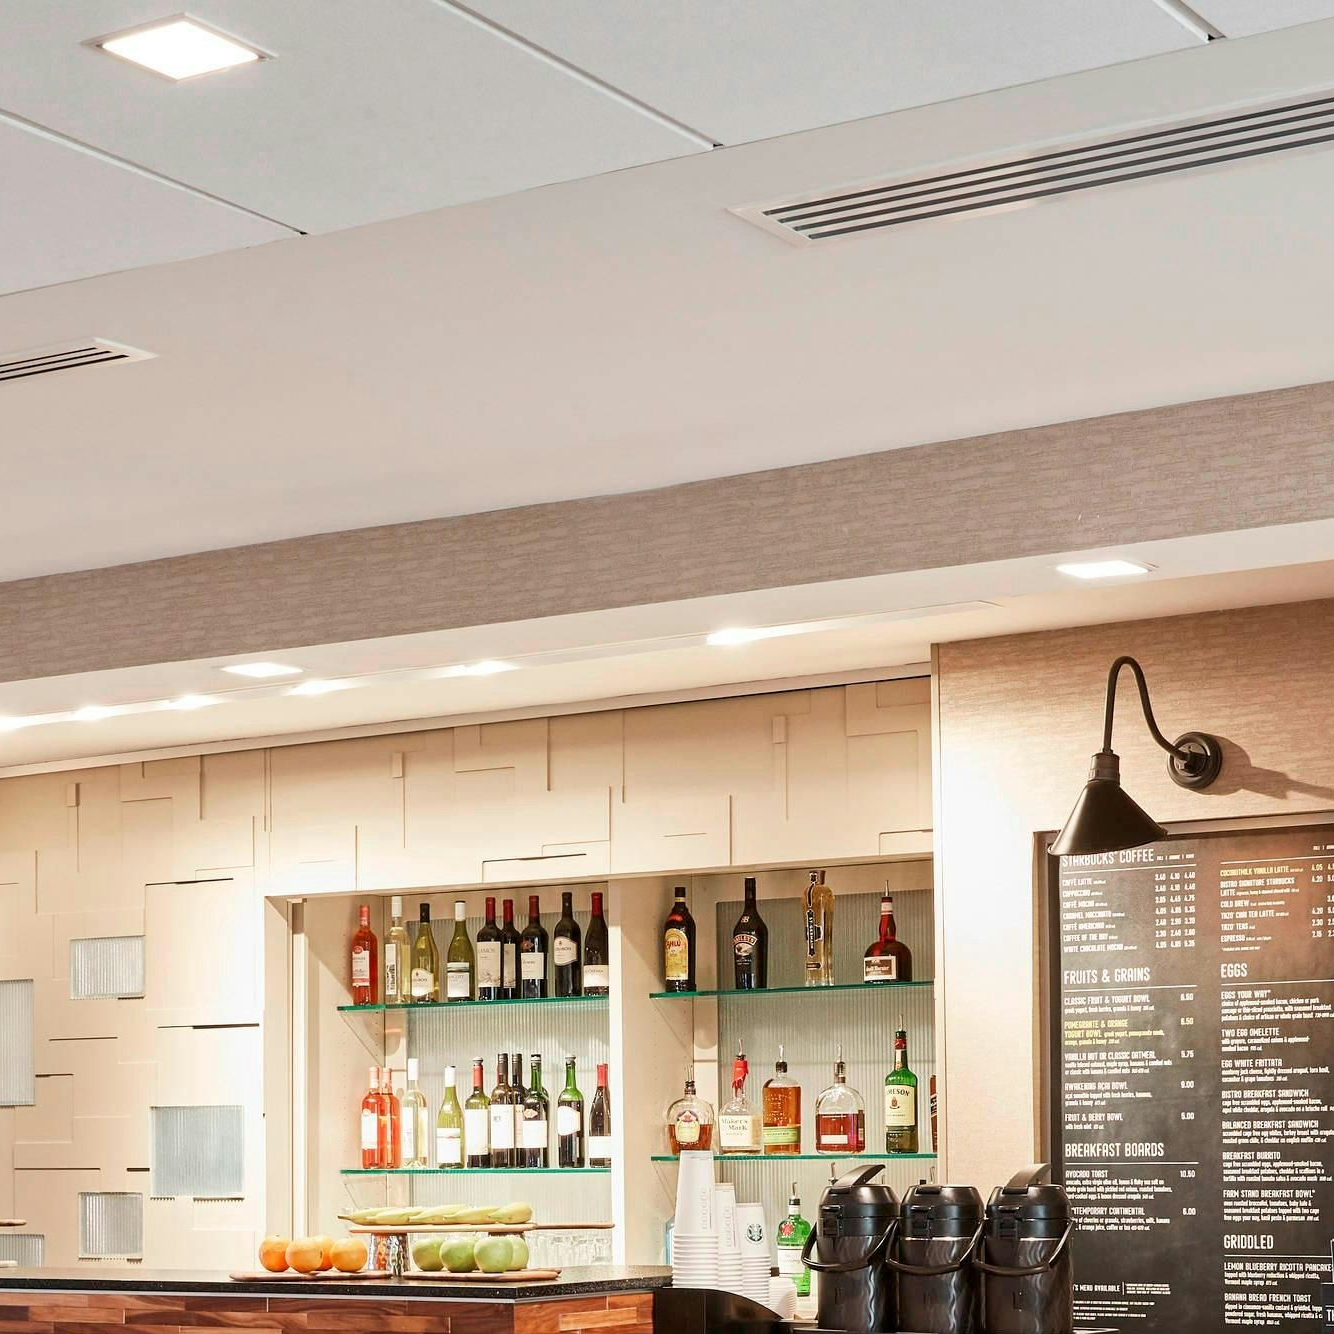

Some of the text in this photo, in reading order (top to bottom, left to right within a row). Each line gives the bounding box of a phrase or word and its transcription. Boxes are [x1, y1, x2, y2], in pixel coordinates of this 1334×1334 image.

[1119, 848, 1155, 864] COFFEE
[1063, 967, 1151, 985] FRUITS & GRAINS
[1220, 963, 1248, 979] EGGS
[1133, 994, 1150, 1003] BOWL
[1220, 990, 1252, 999] EGGS YOUR
[1221, 1027, 1280, 1037] TWO EGG OMELETTE
[1221, 1058, 1283, 1068] EGG WHITE FRITTATA
[1111, 1081, 1128, 1090] BOWL
[1180, 1080, 1194, 1089] 9.00
[1221, 1089, 1309, 1099] BISTRO BREAKFAST SANDWICH
[1064, 1112, 1124, 1122] FRUIT & BERRY BOWL
[1181, 1112, 1195, 1120] 5.00
[1222, 1120, 1319, 1130] BALANCED BREAKFAST SANDWICH
[1065, 1142, 1164, 1158] BREAKFAST BOARDS
[1222, 1151, 1281, 1160] BREAKFAST BURRITO
[1065, 1169, 1108, 1178] AVOCADO TOAST
[1179, 1170, 1196, 1178] 10.50
[1223, 1189, 1294, 1198] FARM STAND BREAKFAST
[1109, 1207, 1145, 1216] CONTINENTAL
[1182, 1207, 1197, 1216] 6.00
[1224, 1234, 1274, 1250] GRIDDLED
[1224, 1262, 1244, 1271] LEMON
[1245, 1262, 1278, 1271] BLUEBERRY
[1279, 1263, 1303, 1272] RICOTTA
[1224, 1293, 1312, 1303] BANANA BREAD FRENCH TOAST
